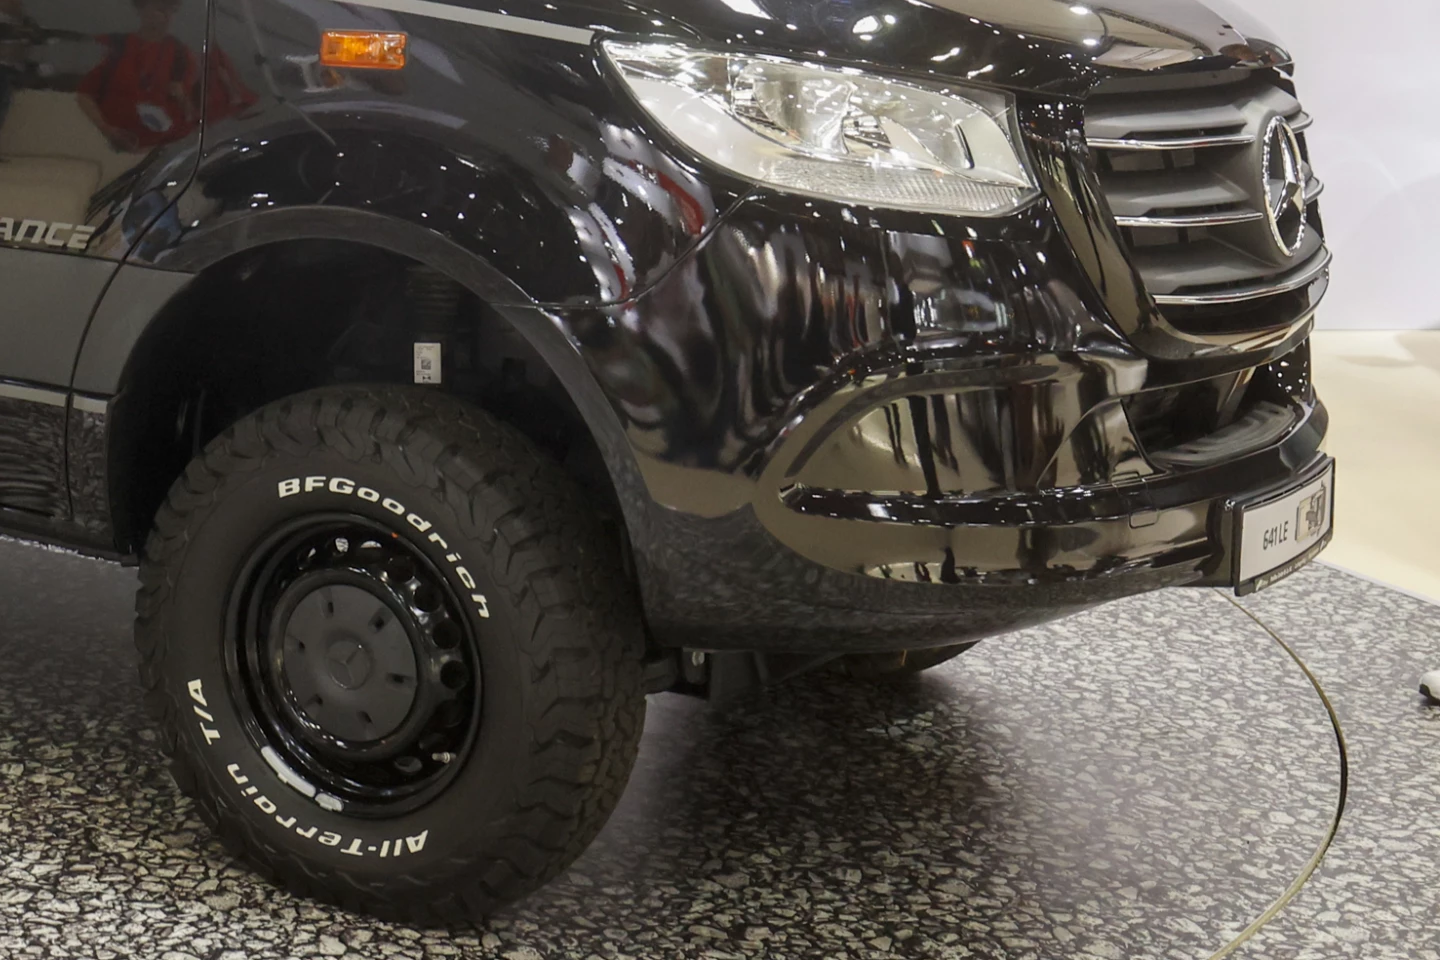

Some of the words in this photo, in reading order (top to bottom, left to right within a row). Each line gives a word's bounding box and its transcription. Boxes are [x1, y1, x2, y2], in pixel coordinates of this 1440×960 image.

[277, 475, 490, 619] BFGoodrich
[187, 678, 221, 746] T/A
[226, 762, 429, 858] All-Terrain
